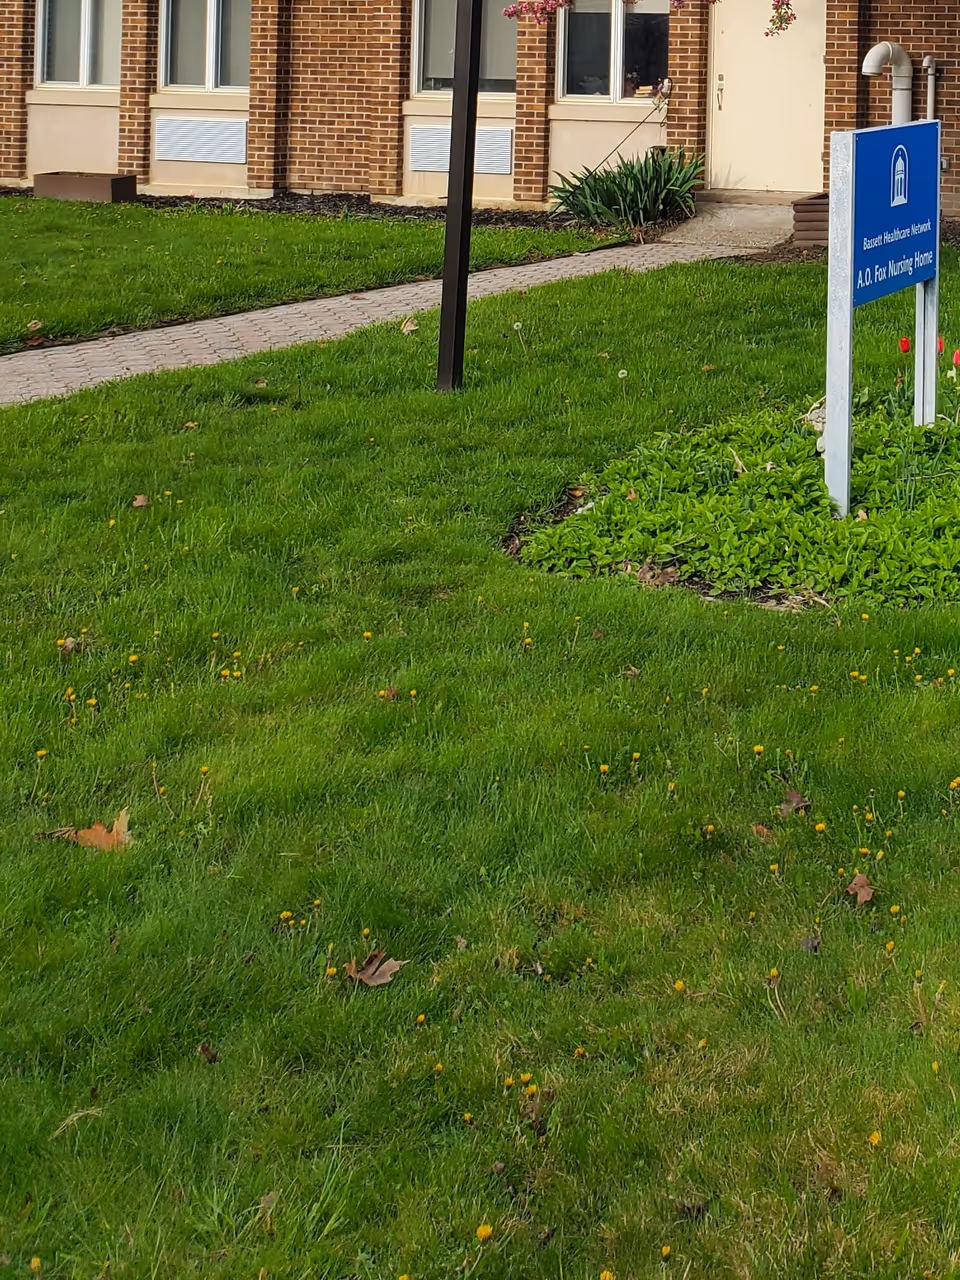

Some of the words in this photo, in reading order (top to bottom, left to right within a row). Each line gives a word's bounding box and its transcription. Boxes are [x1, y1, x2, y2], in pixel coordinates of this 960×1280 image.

[863, 234, 883, 250] Bassett
[883, 227, 910, 244] Healthcare
[911, 218, 931, 236] Network
[857, 267, 872, 289] A.O.
[874, 264, 887, 283] Fox
[888, 255, 913, 276] Nursing
[914, 250, 933, 269] Home
